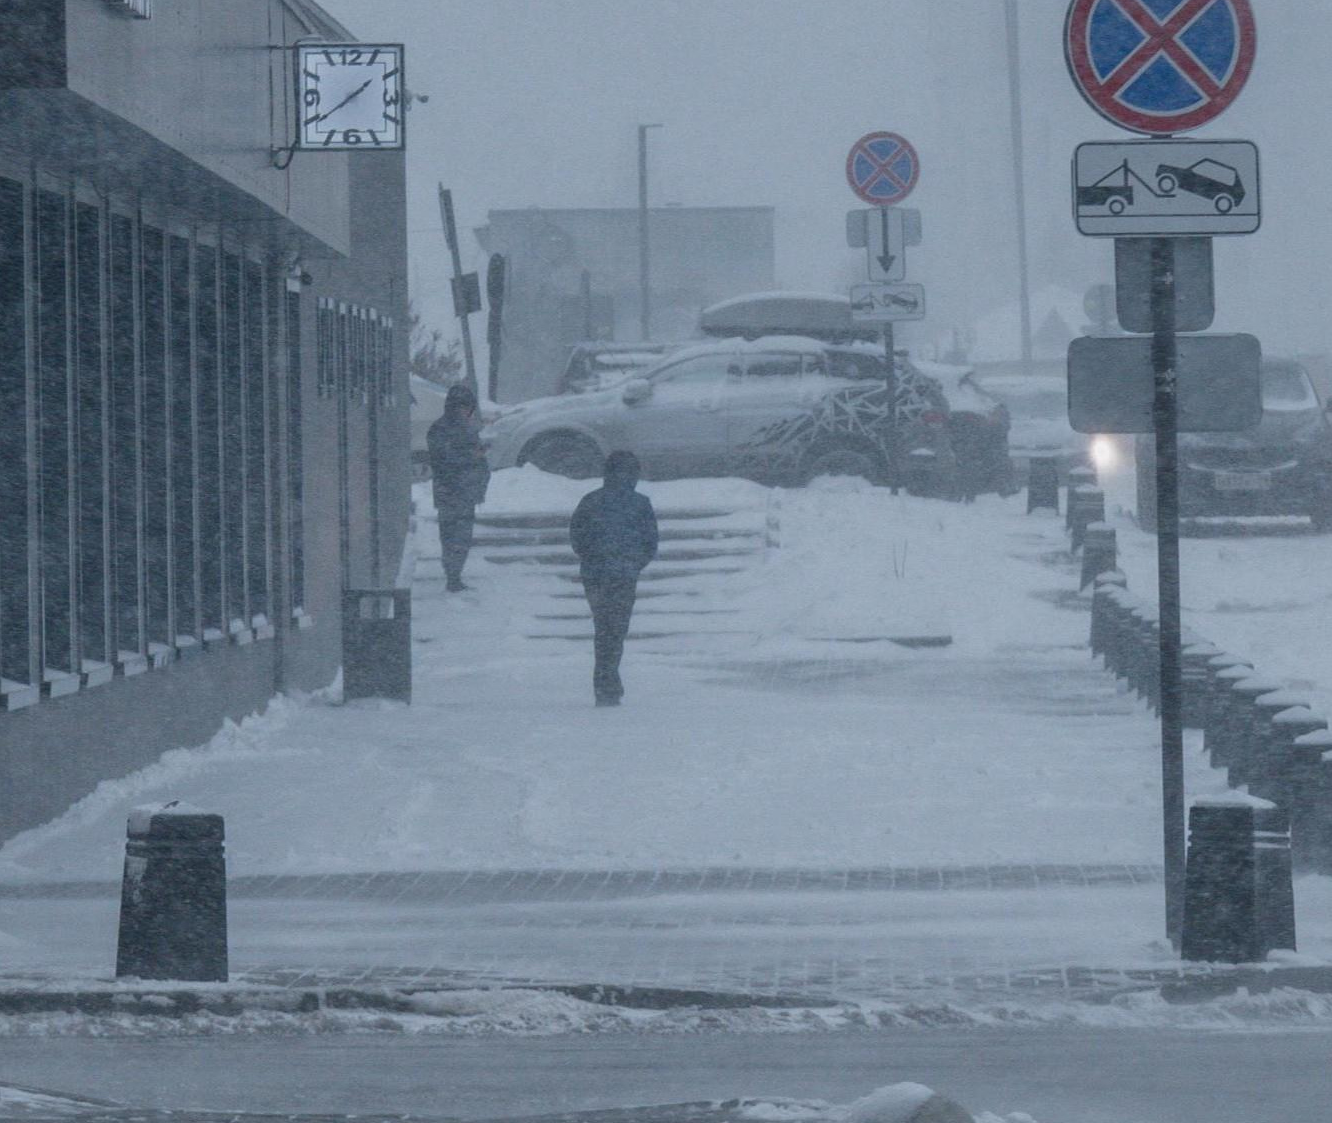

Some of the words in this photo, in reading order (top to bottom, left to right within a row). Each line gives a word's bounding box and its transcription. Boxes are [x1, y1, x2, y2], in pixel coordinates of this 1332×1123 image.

[339, 49, 362, 66] 12
[382, 89, 399, 107] 3
[342, 128, 362, 145] 6
